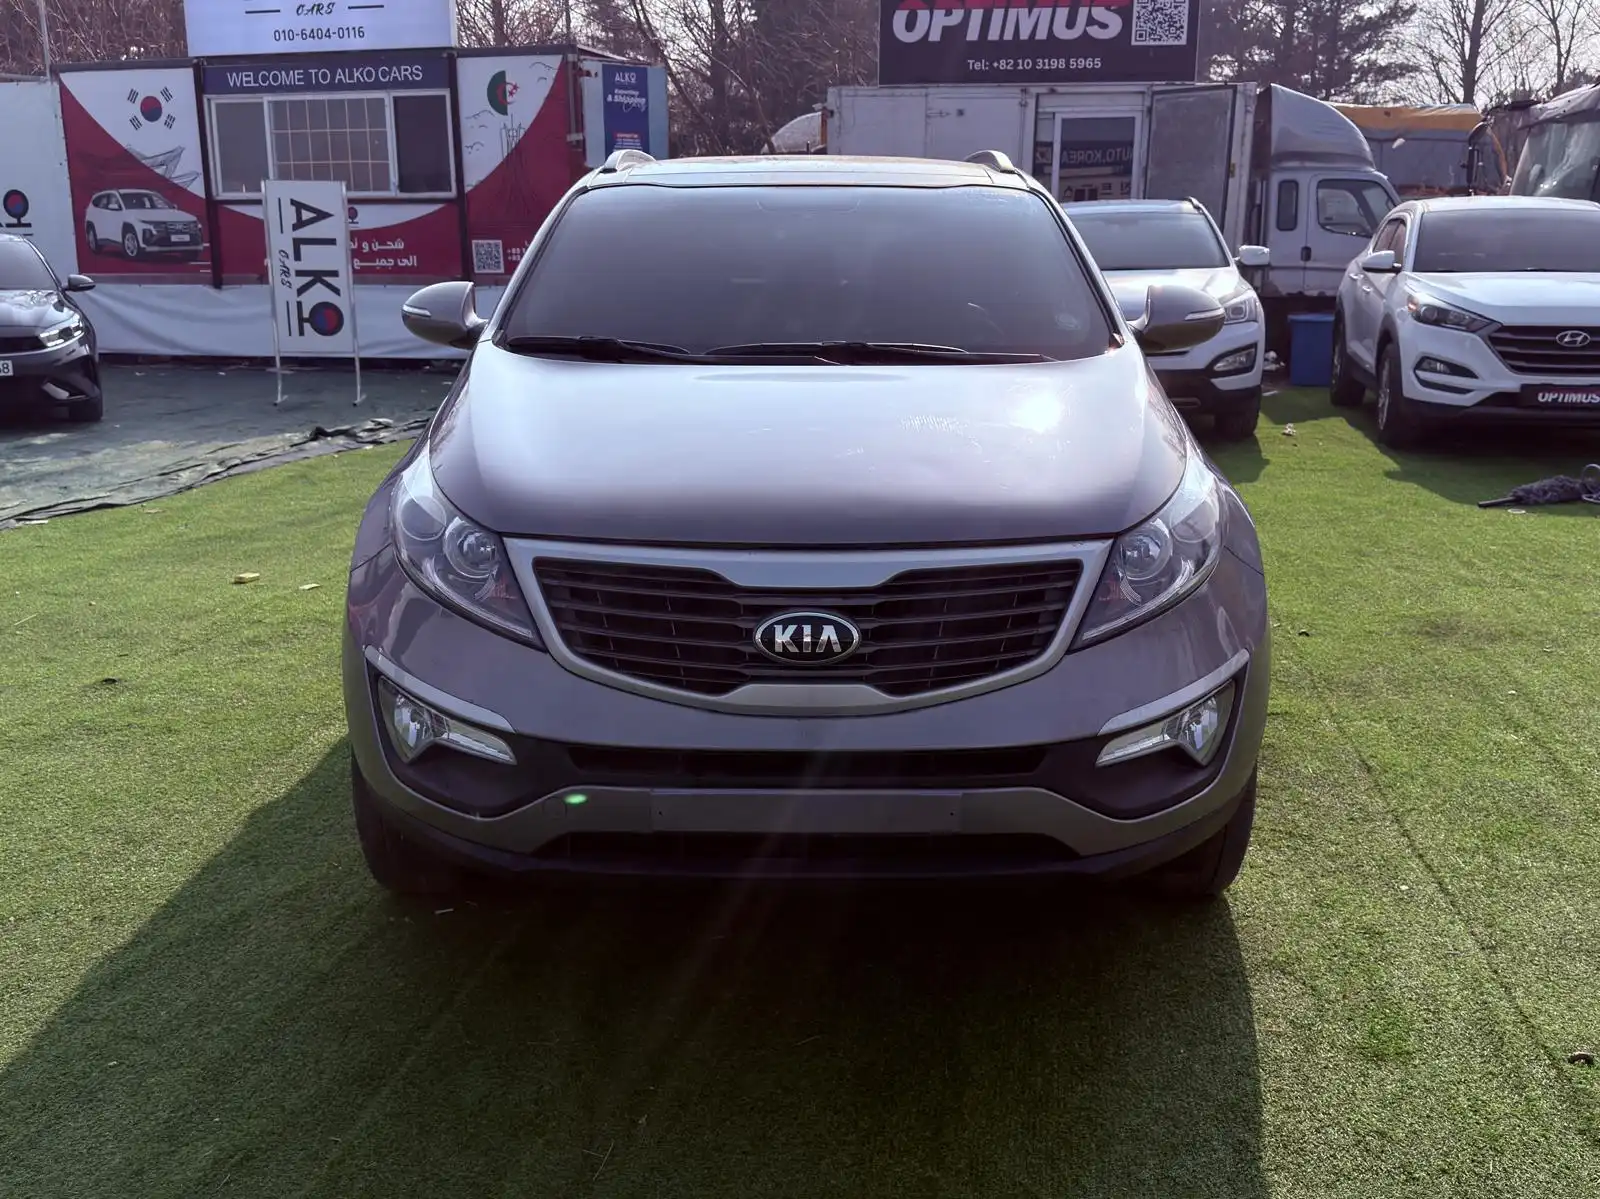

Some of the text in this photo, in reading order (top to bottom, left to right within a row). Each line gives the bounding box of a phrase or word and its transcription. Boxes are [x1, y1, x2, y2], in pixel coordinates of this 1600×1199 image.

[892, 0, 1131, 43] OPTIMUS
[273, 26, 365, 42] 010-6404-0116
[967, 58, 1101, 70] Tel: +82 10 3198 5965
[227, 65, 423, 87] WELCOME TO ALKO CARS
[290, 198, 345, 336] ALKO
[1537, 390, 1600, 404] OPTIMUS
[773, 624, 842, 653] KIA
